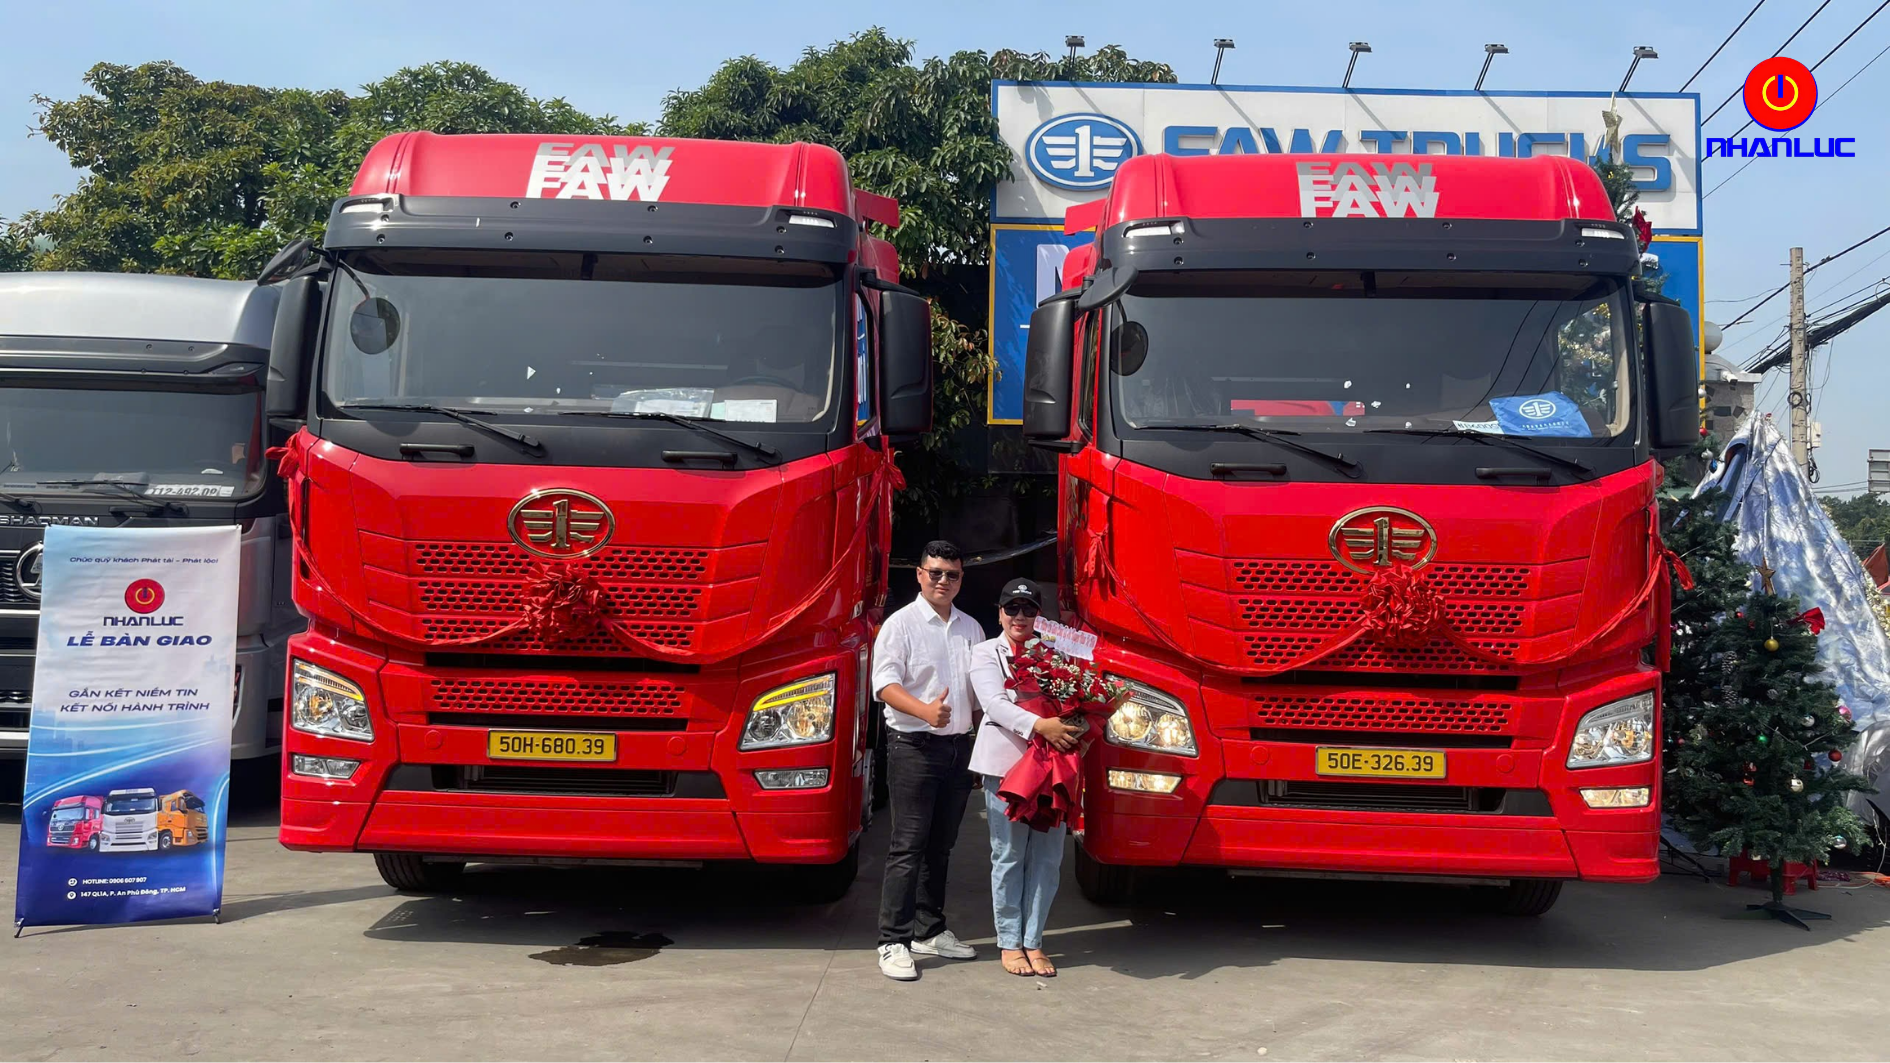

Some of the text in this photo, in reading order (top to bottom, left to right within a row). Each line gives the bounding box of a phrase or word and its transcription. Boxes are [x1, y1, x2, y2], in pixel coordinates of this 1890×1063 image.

[103, 616, 184, 627] NHANLUC
[67, 631, 212, 646] LỄ BÀN GIAO
[105, 688, 132, 697] KẾT
[60, 701, 210, 712] KẾT NỐI HÀNH TRÌNH
[500, 736, 604, 755] 50H-680.39
[1327, 753, 1433, 772] 50E-326.39
